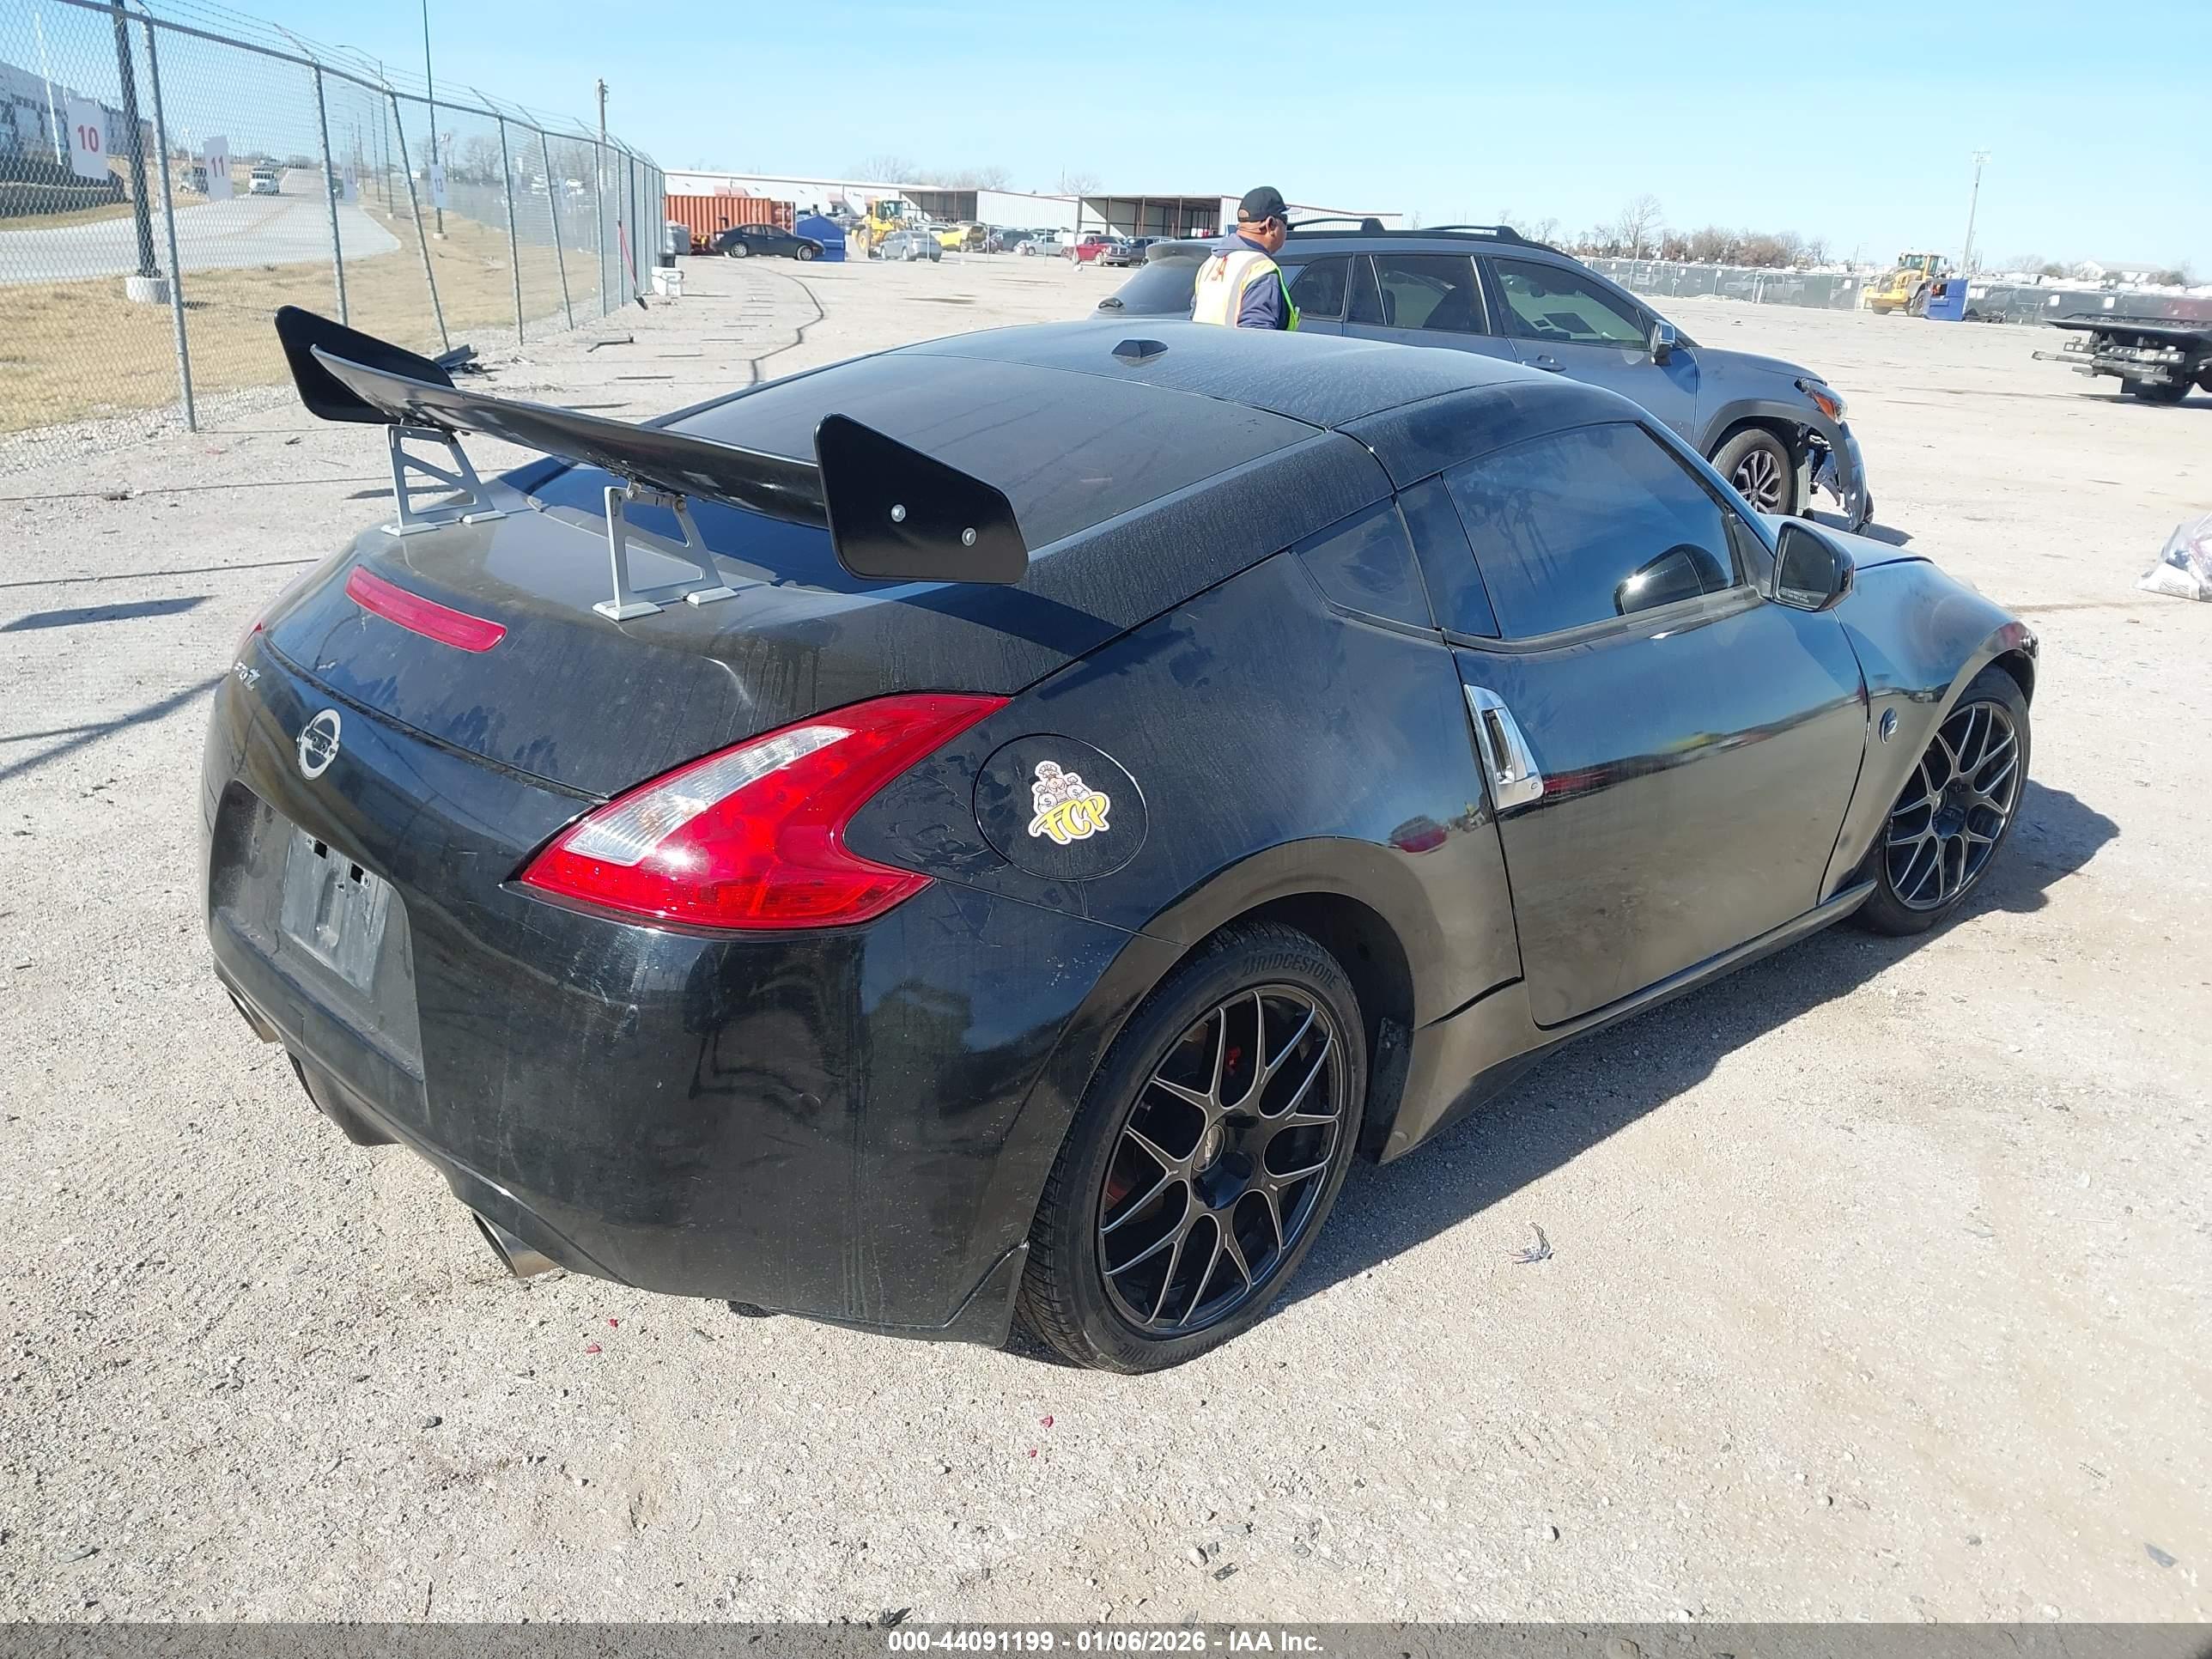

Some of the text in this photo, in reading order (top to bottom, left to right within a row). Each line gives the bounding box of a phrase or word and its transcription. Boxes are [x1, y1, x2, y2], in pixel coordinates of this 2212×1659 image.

[77, 124, 100, 153] 10
[210, 155, 226, 179] 11
[1032, 794, 1107, 842] FCP
[1243, 952, 1341, 989] BRIDGESTONE
